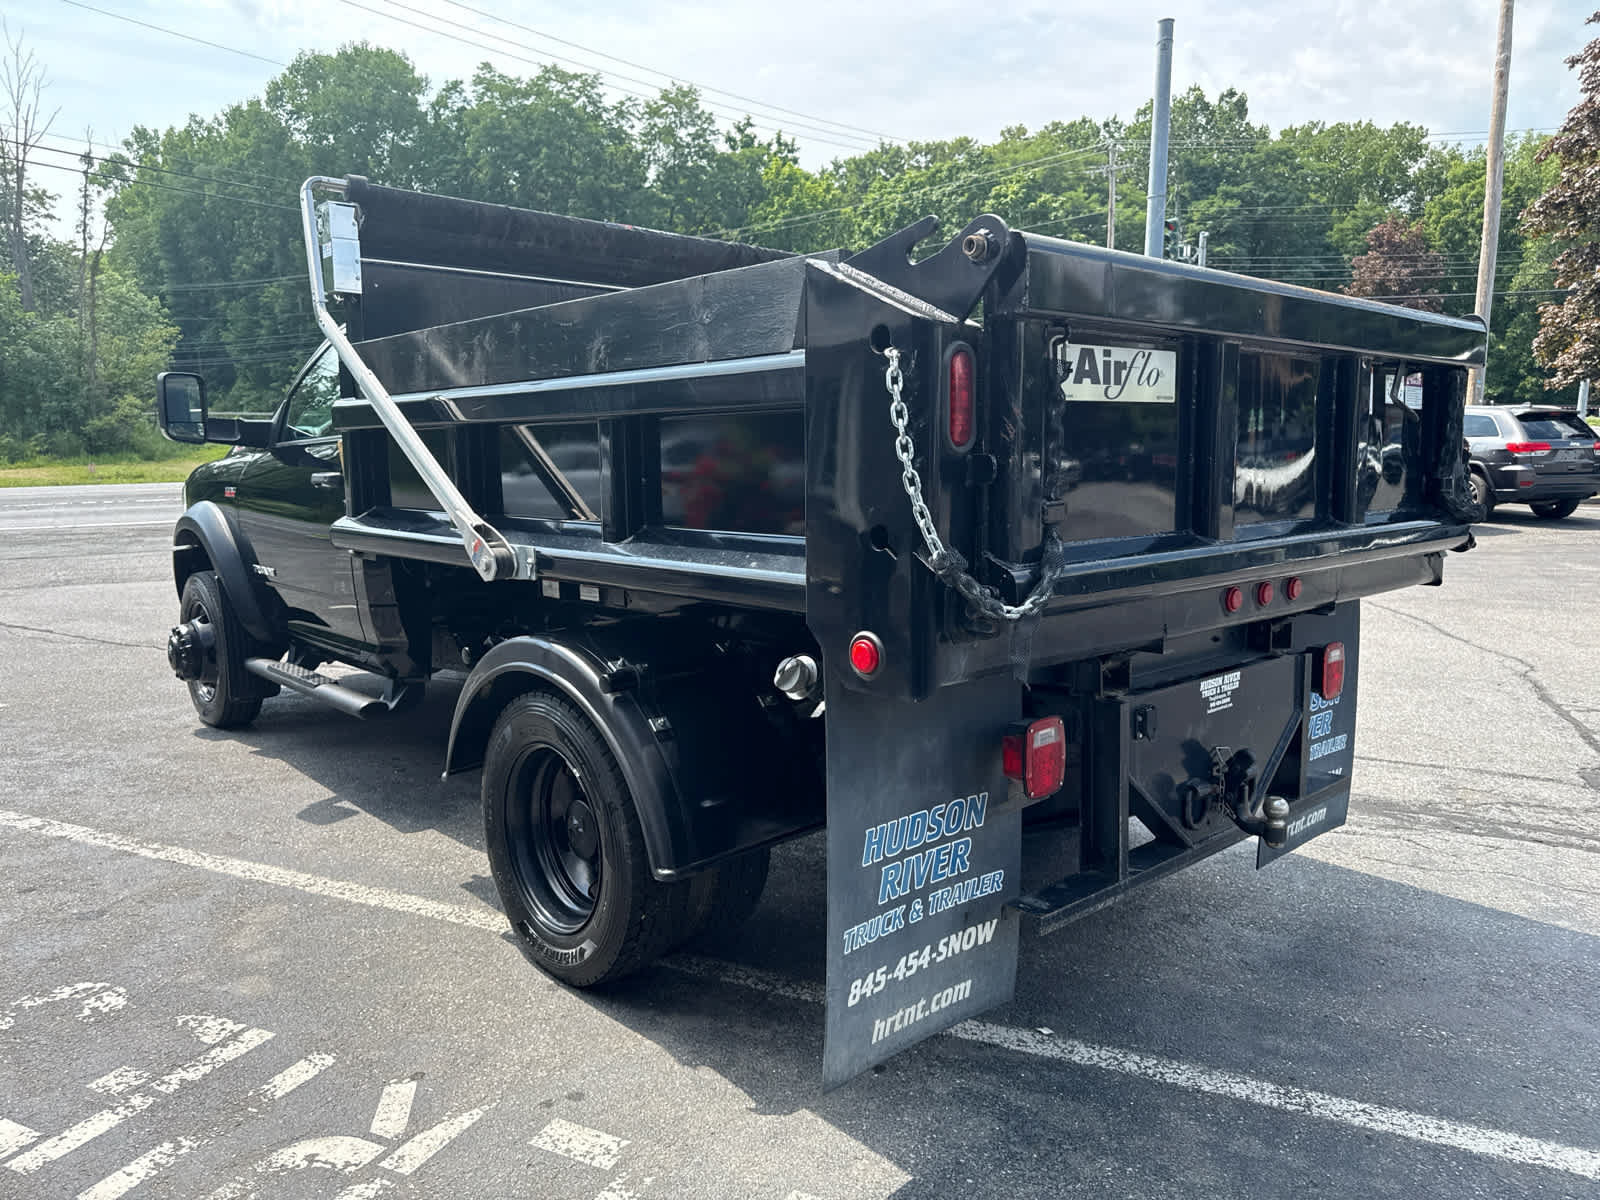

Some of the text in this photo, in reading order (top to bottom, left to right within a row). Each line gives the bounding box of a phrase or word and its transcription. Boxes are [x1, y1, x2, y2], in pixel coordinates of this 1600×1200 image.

[1073, 347, 1160, 400] Airflo
[861, 791, 989, 867] HUDSON
[877, 836, 972, 905] RIVER
[843, 869, 1004, 955] TRUCK & TRAILER
[847, 918, 998, 1007] 845-454-SNOW
[871, 978, 972, 1045] hrtnt.com
